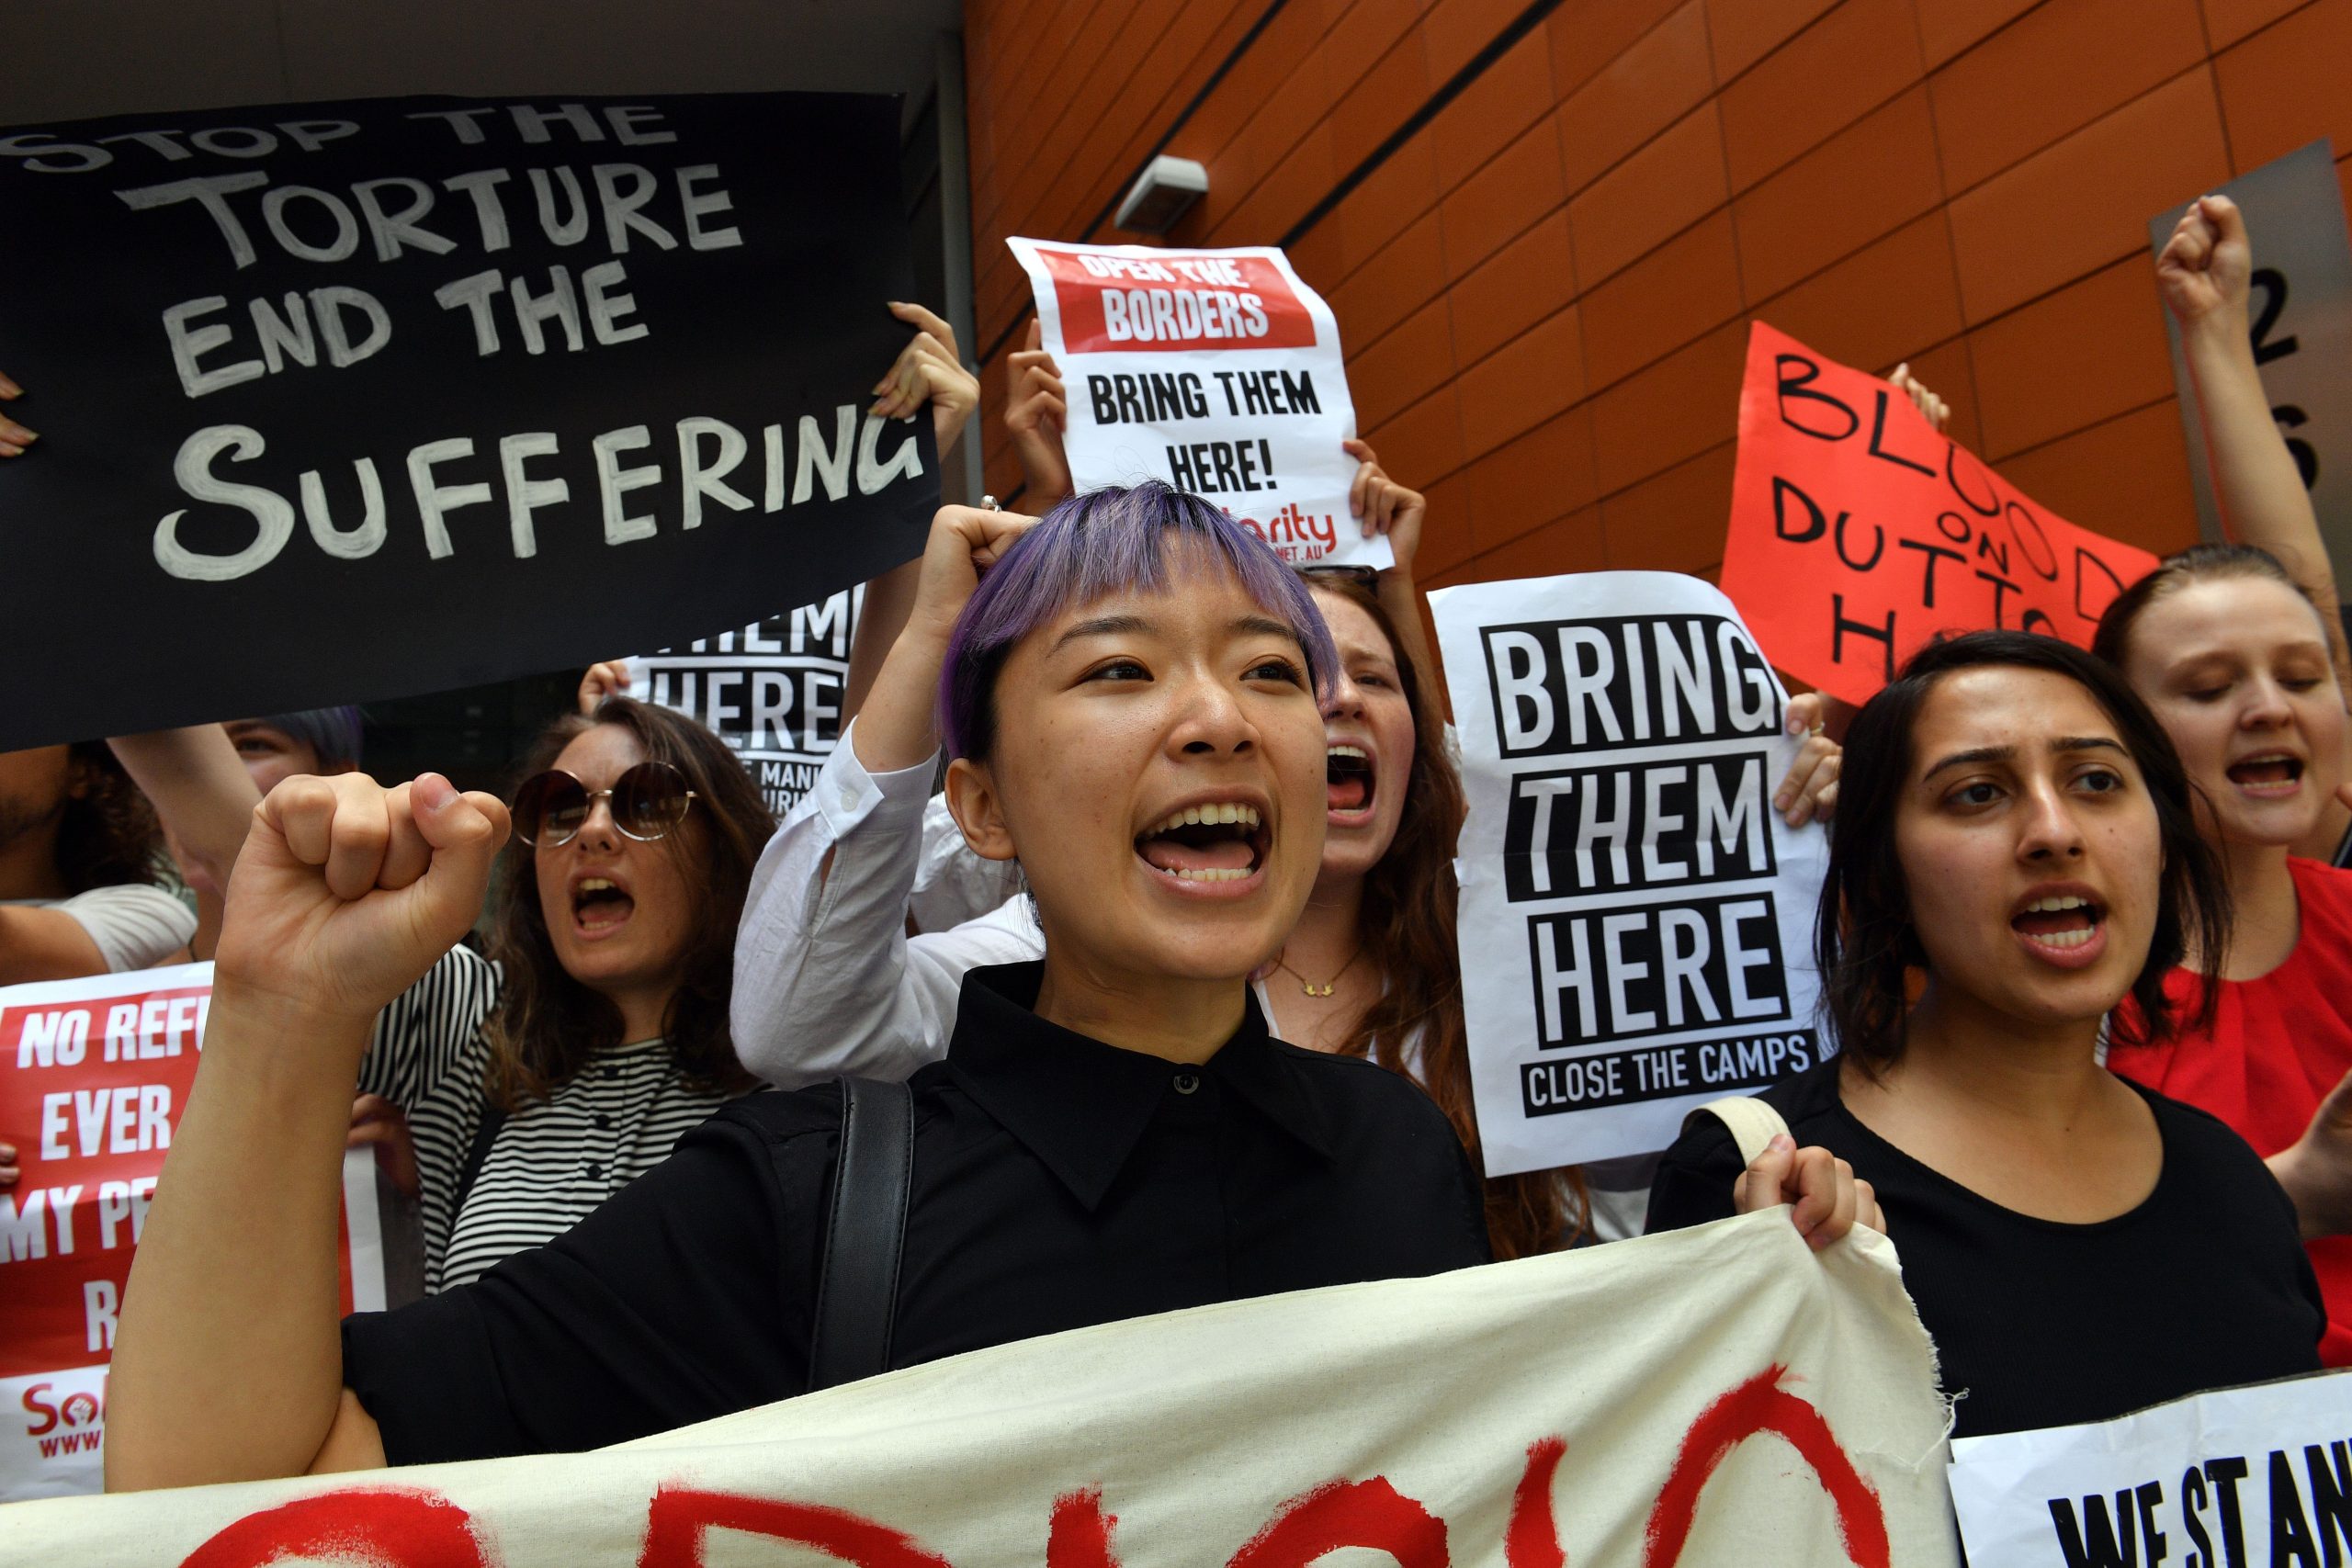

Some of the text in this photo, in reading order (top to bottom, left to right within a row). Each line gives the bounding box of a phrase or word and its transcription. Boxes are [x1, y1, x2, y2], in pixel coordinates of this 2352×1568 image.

[0, 104, 678, 173] STOP THE
[113, 164, 742, 268] TORTURE
[1078, 254, 1250, 288] OPEN THE
[163, 260, 649, 398] END THE
[1101, 288, 1269, 342] BORDERS
[1087, 370, 1322, 425] BRING THEM
[153, 404, 925, 581] SUFFERING
[1166, 438, 1278, 494] HERE!
[1937, 511, 2009, 575] ON
[1488, 619, 1776, 751] BRING
[1519, 758, 1768, 892] THEM
[1536, 899, 1783, 1043] HERE
[17, 1010, 90, 1069] NO
[1528, 1034, 1810, 1108] CLOSE THE CAMPS
[40, 1085, 172, 1161] EVER
[0, 1184, 84, 1265] MY
[2181, 1438, 2352, 1568] STAN
